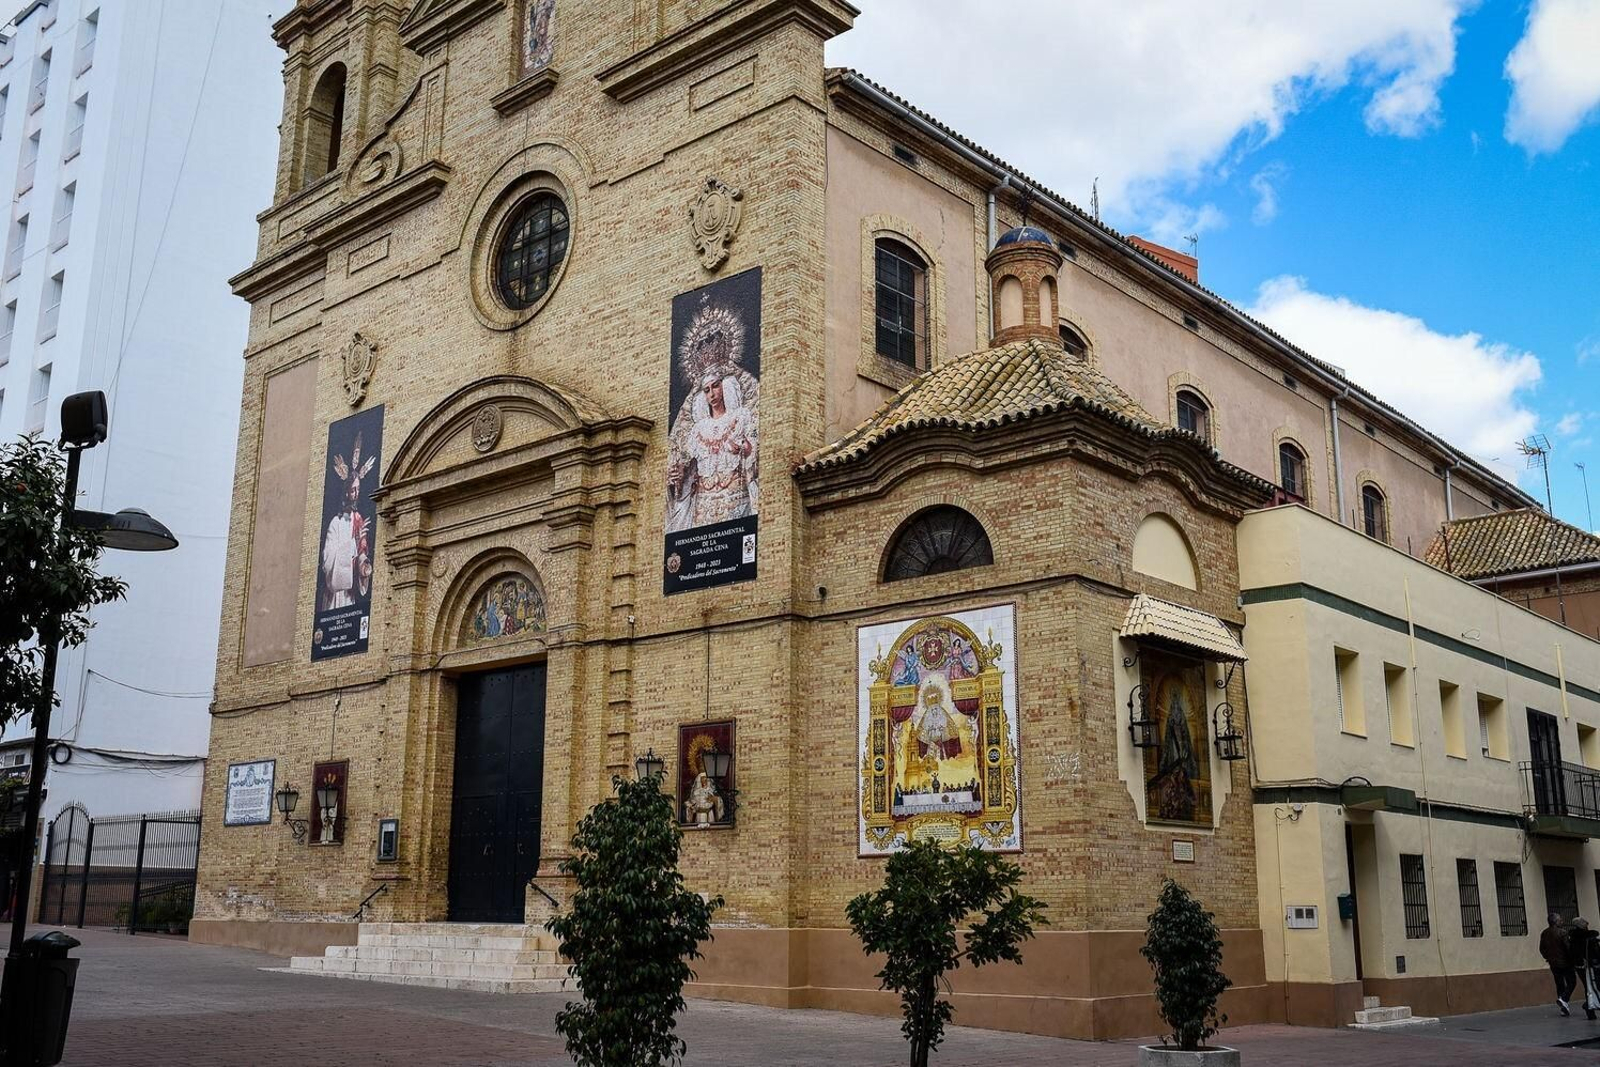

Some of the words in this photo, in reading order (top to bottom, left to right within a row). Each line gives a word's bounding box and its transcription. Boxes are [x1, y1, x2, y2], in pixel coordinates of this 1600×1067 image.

[676, 535, 708, 546] HERMANDAD
[708, 526, 745, 538] SACRAMENTAL
[690, 546, 714, 556] SAGRADA
